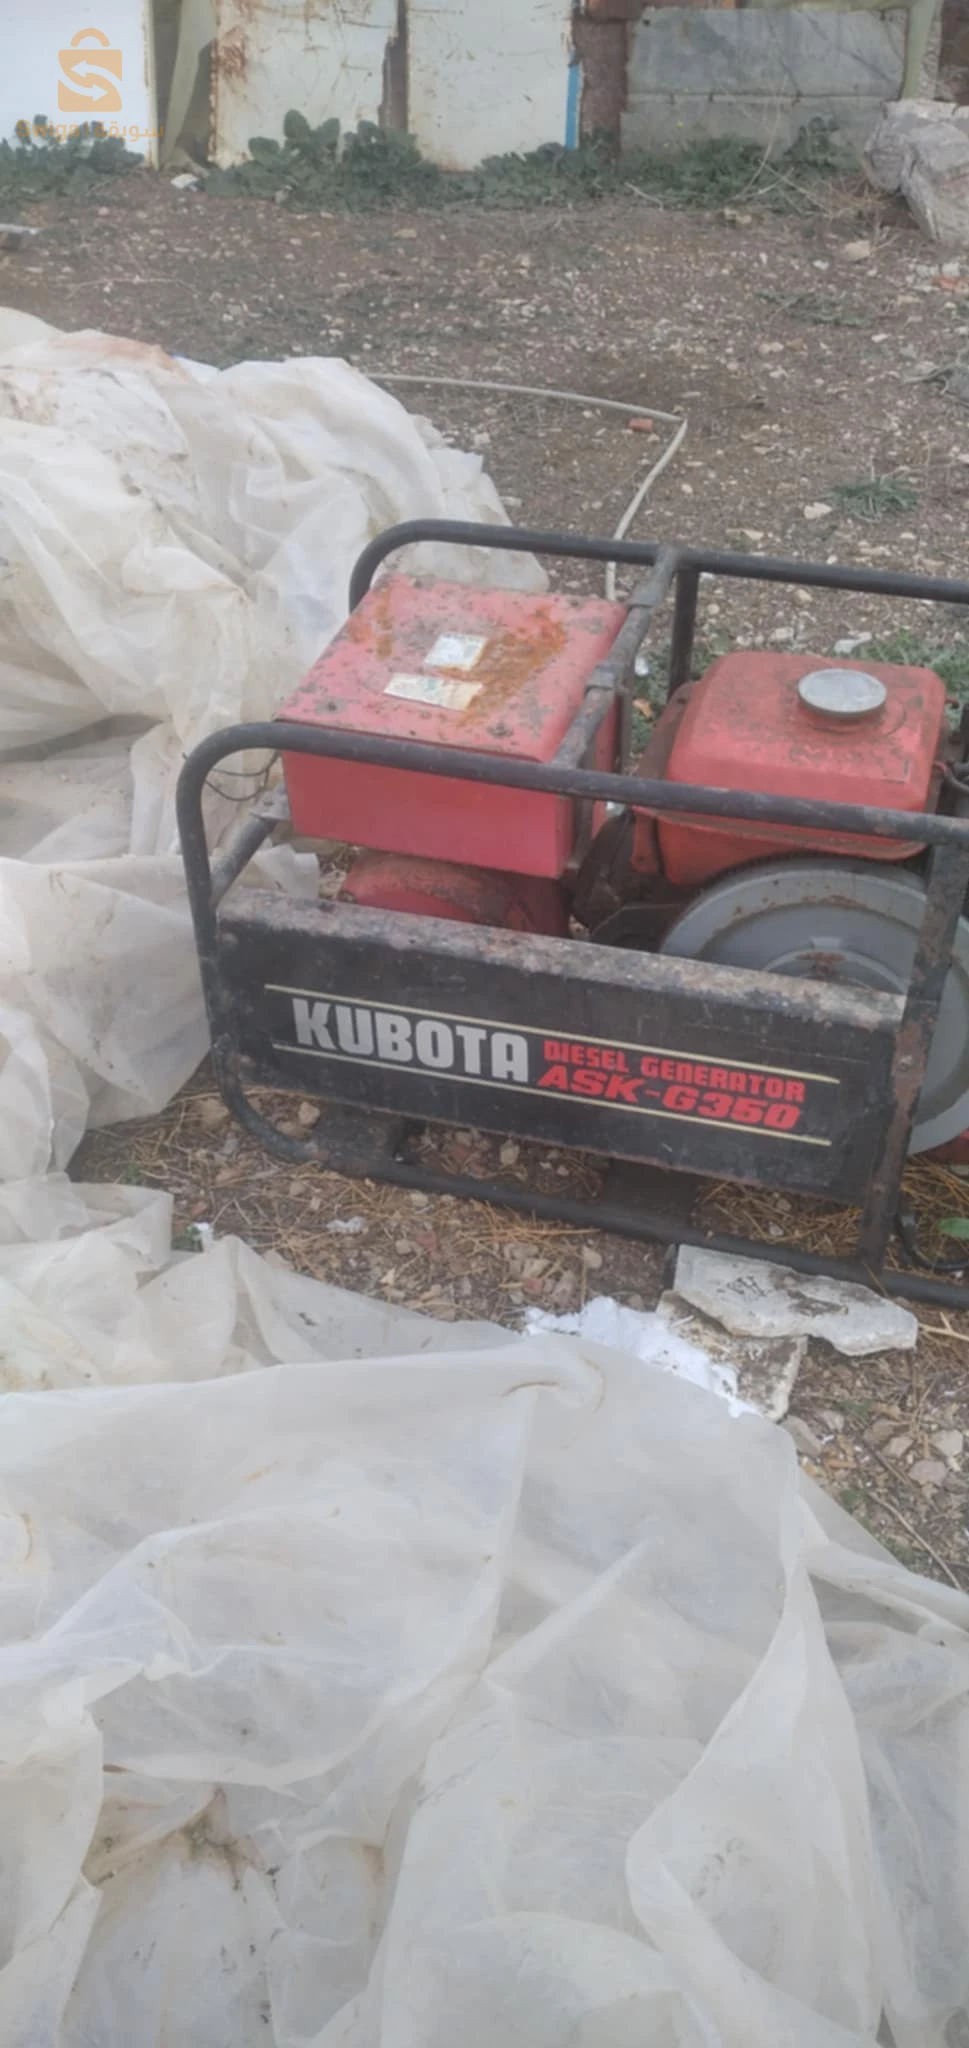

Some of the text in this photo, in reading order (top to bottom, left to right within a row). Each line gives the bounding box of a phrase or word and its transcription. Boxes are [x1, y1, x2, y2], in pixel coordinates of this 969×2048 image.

[292, 998, 529, 1083] KUBOTA
[543, 1040, 805, 1103] DIESEL GENERATOR
[538, 1065, 800, 1130] ASK-G350
